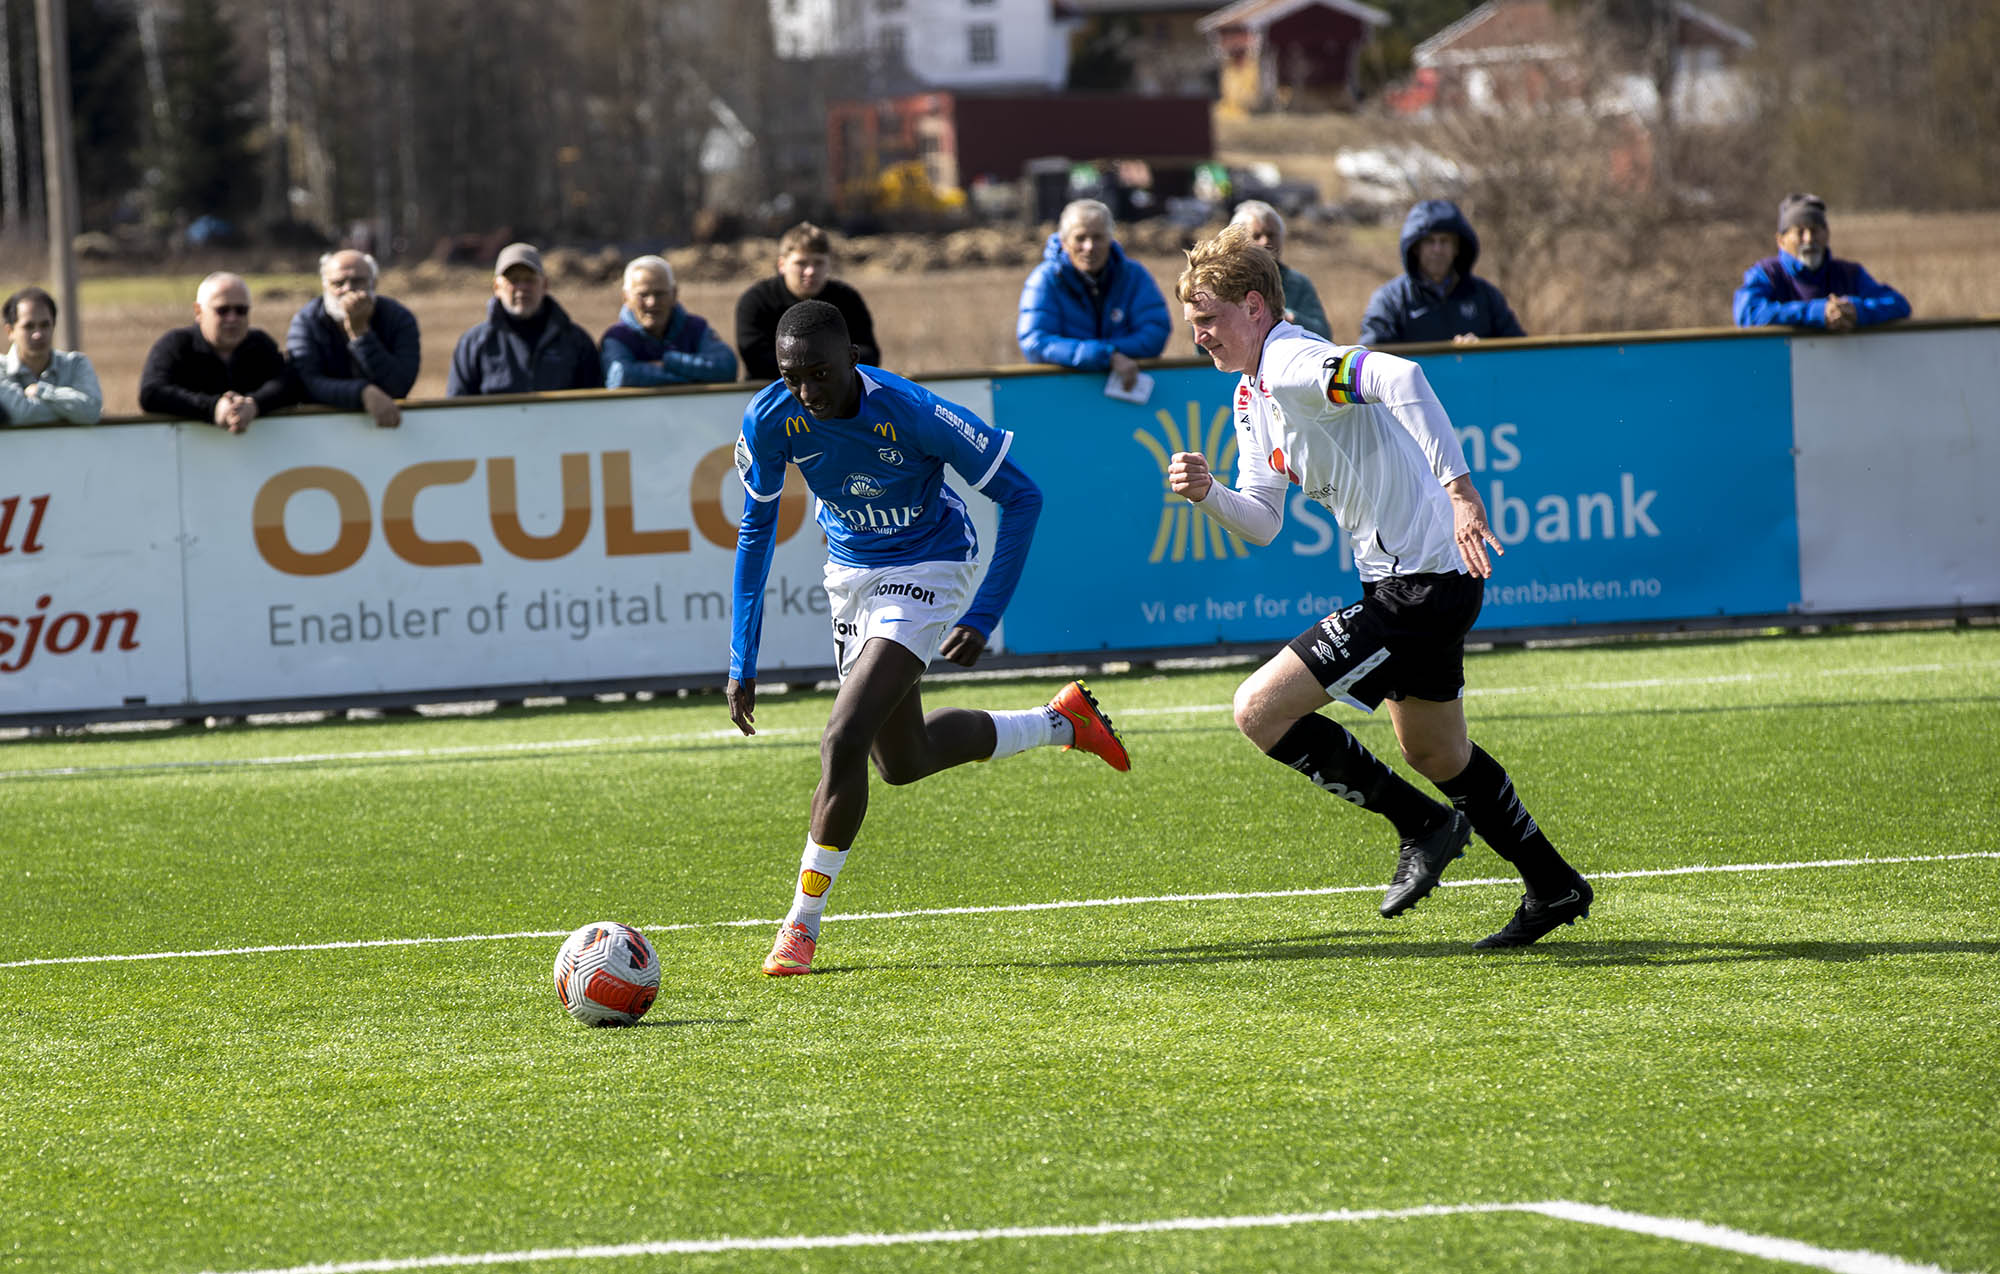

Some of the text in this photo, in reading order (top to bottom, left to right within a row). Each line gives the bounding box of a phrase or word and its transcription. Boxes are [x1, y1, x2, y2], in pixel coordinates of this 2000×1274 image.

[252, 443, 828, 577] OCULO
[269, 599, 450, 646] Enabler
[467, 590, 507, 635] of
[525, 583, 666, 640] digital
[1141, 602, 1166, 624] Vi
[1173, 603, 1199, 623] er
[1205, 597, 1247, 620] her
[1254, 593, 1289, 618] for
[1342, 605, 1363, 619] 8
